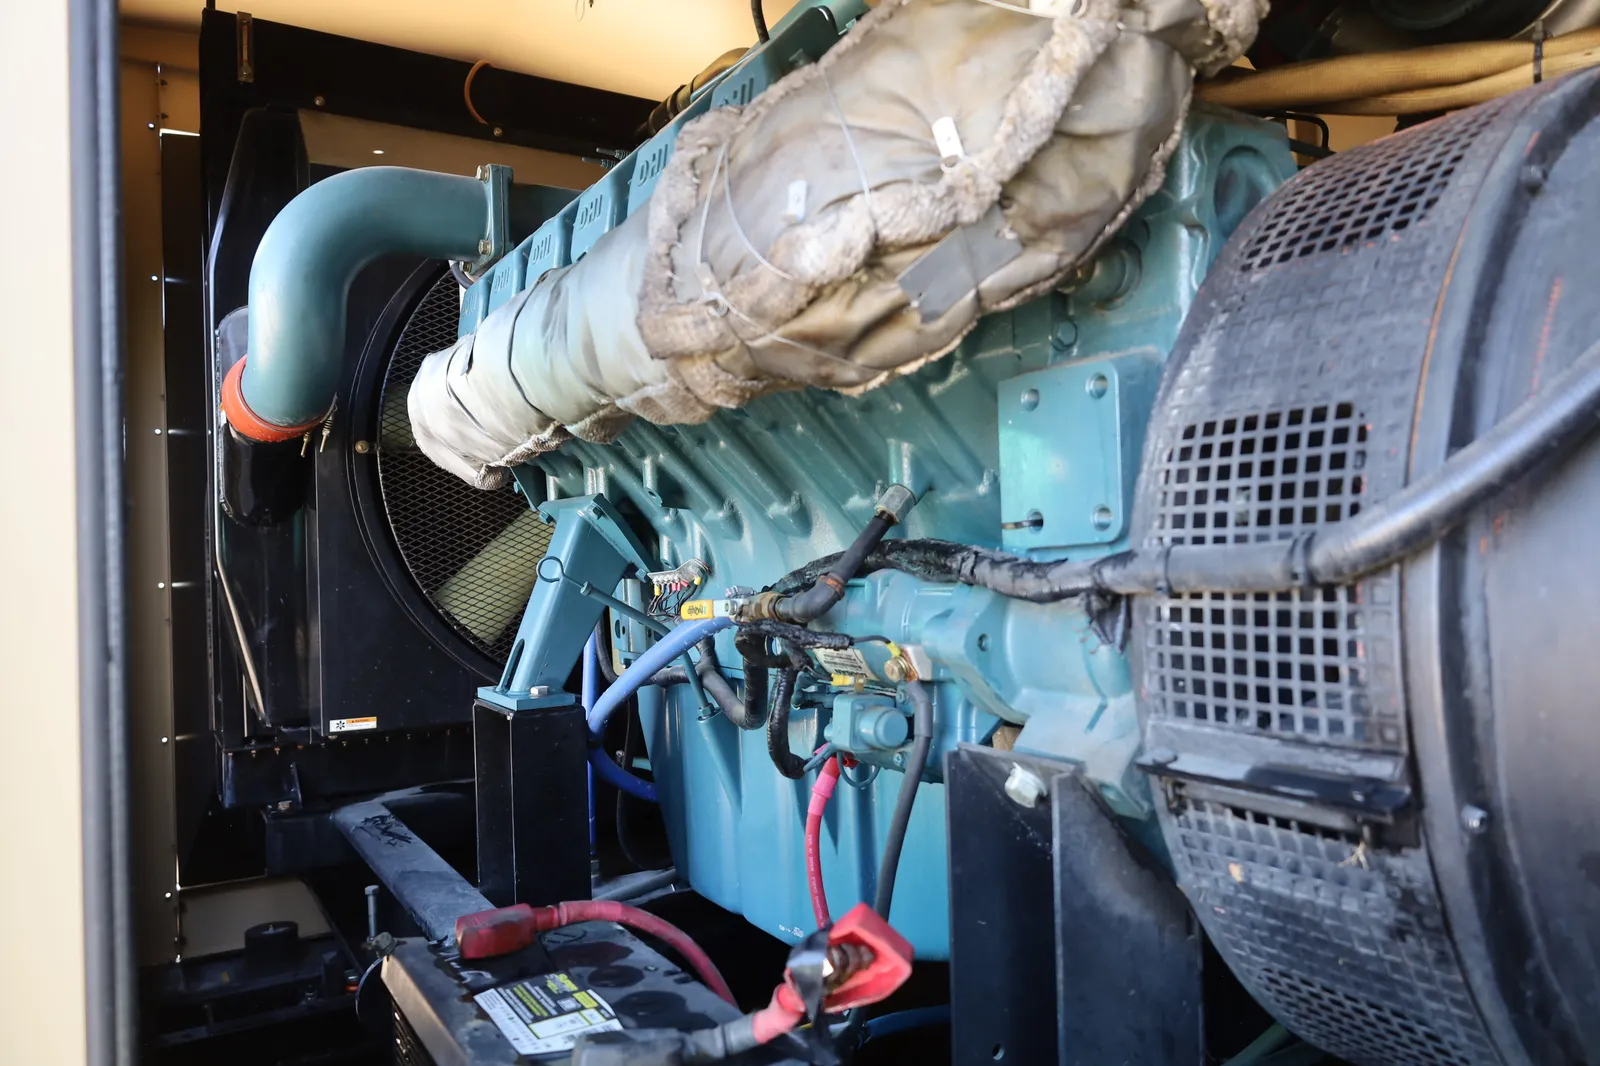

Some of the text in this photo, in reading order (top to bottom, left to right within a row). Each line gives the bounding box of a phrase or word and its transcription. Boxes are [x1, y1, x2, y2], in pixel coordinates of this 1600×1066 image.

[639, 143, 669, 187] DHI
[579, 194, 603, 228] DHI
[532, 234, 552, 265] DHI
